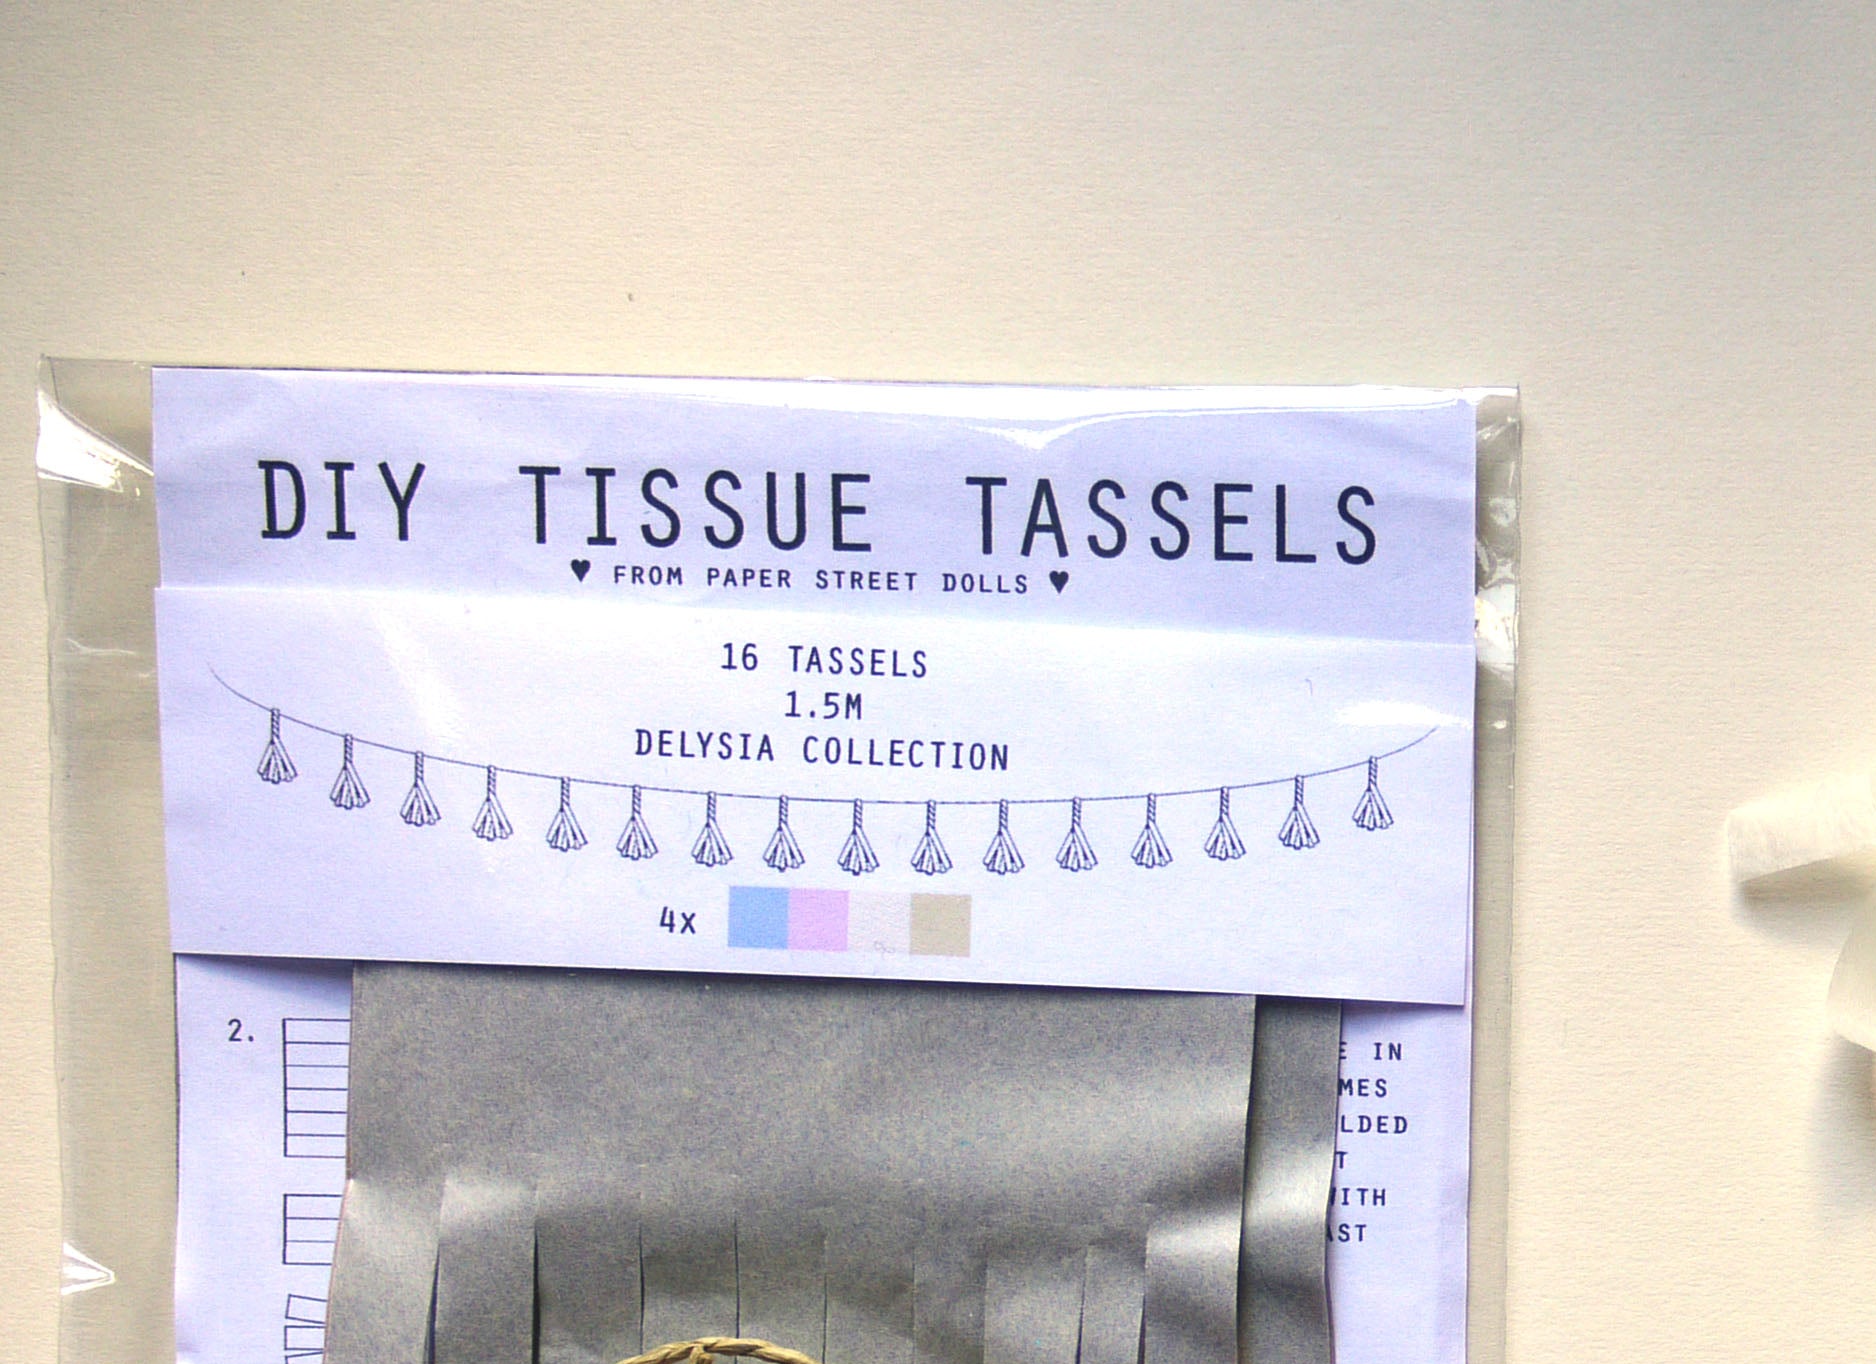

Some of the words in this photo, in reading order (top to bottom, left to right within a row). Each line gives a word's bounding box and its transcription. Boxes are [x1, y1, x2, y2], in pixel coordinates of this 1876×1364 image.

[257, 459, 426, 542] DIY
[518, 465, 873, 552] TISSUE
[965, 475, 1378, 565] TASSELS
[613, 564, 683, 587] FROM
[706, 567, 792, 588] PAPER
[814, 569, 918, 592] STREET
[942, 572, 1029, 595] DOLLS
[719, 642, 759, 671] 16
[788, 645, 928, 679] TASSELS
[784, 690, 863, 721] 1.5M
[635, 728, 775, 762] DELYSIA
[802, 735, 1010, 772] COLLECTION
[658, 906, 697, 934] 4x
[227, 1018, 256, 1043] 2.
[1373, 1041, 1402, 1061] IN
[1340, 1114, 1408, 1135] LDED
